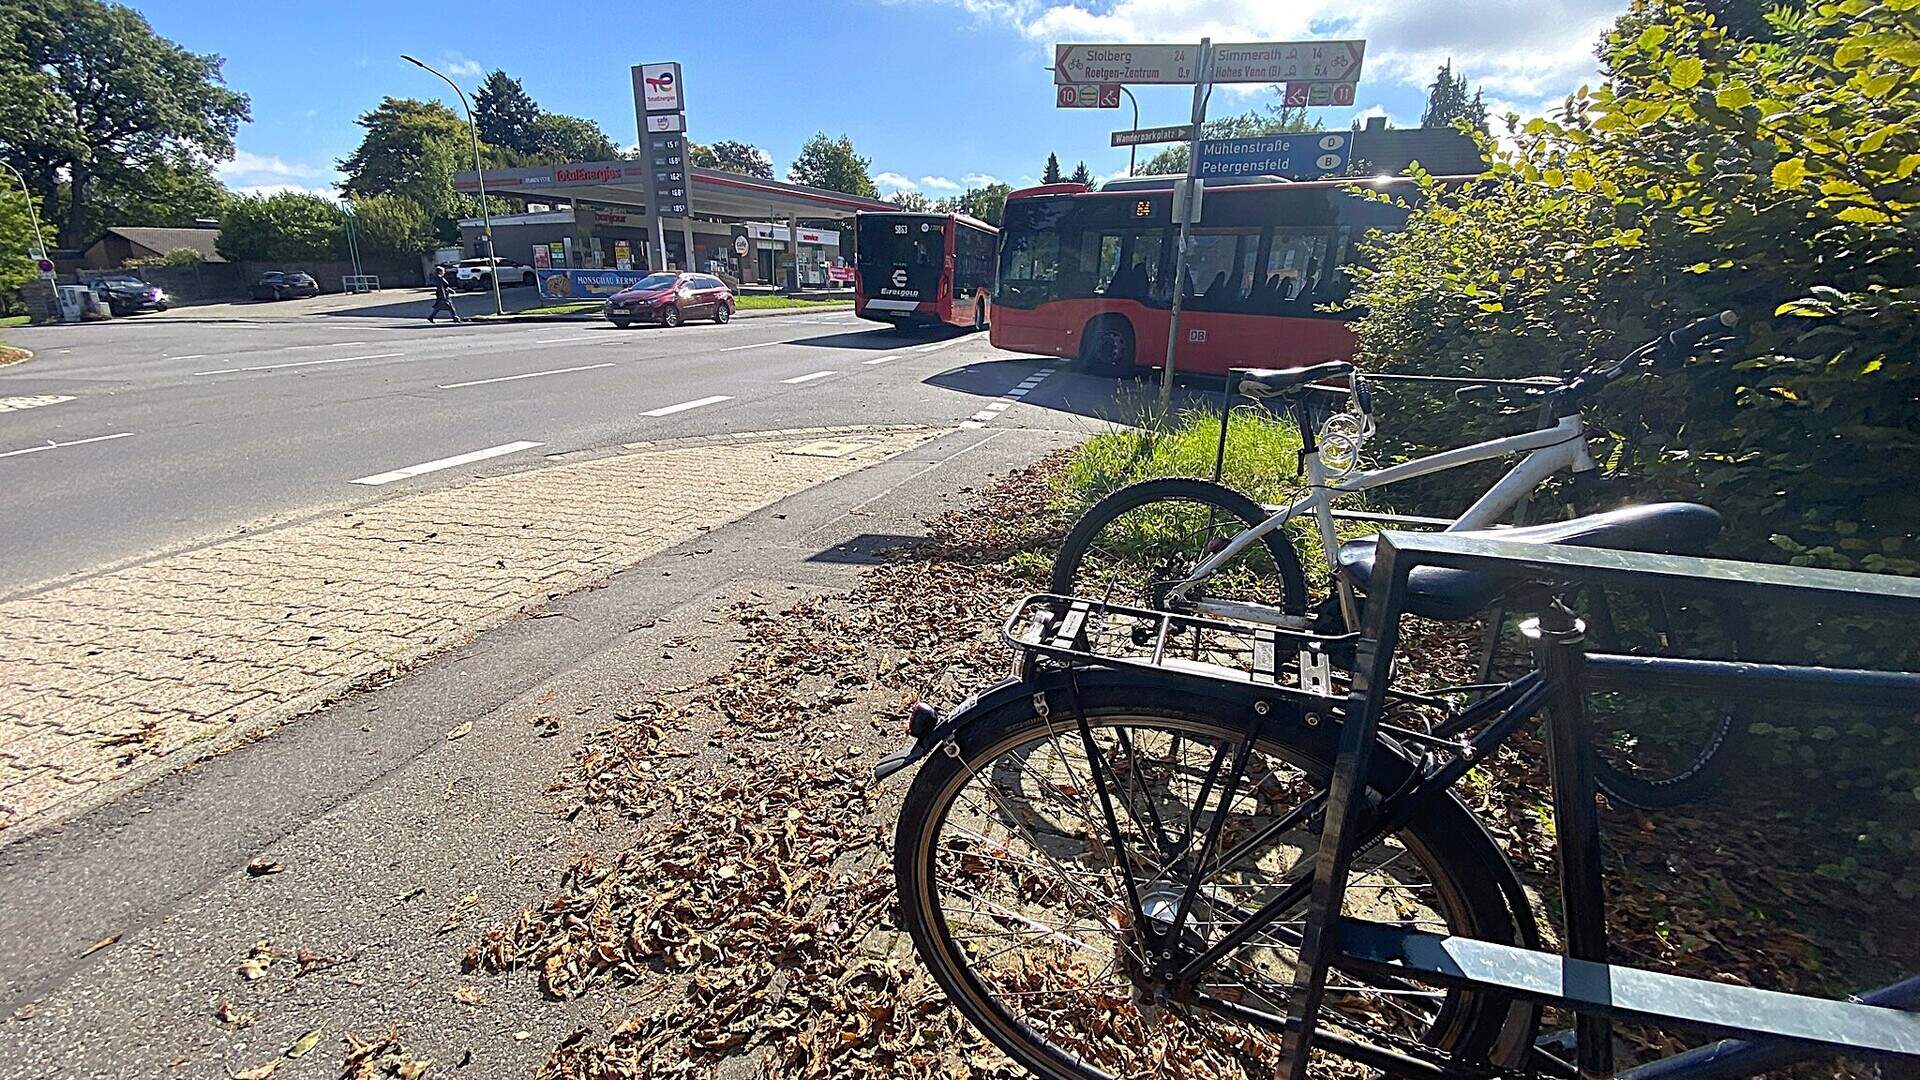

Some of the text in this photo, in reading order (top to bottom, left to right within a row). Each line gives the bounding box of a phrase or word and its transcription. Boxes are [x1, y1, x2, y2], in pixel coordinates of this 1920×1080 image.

[1087, 50, 1132, 64] Stolberg
[1218, 49, 1281, 61] Simmerath
[1085, 67, 1160, 80] Roetgen-Zentrum
[1215, 66, 1242, 78] Hohes
[1245, 66, 1266, 77] Venn
[1062, 90, 1073, 102] 10
[1340, 88, 1349, 100] 11
[1115, 129, 1175, 143] Wanderparkplatz
[1204, 138, 1335, 156] Mühlenstraße D
[1202, 157, 1333, 175] Petergensfeld B
[1191, 331, 1205, 341] DB
